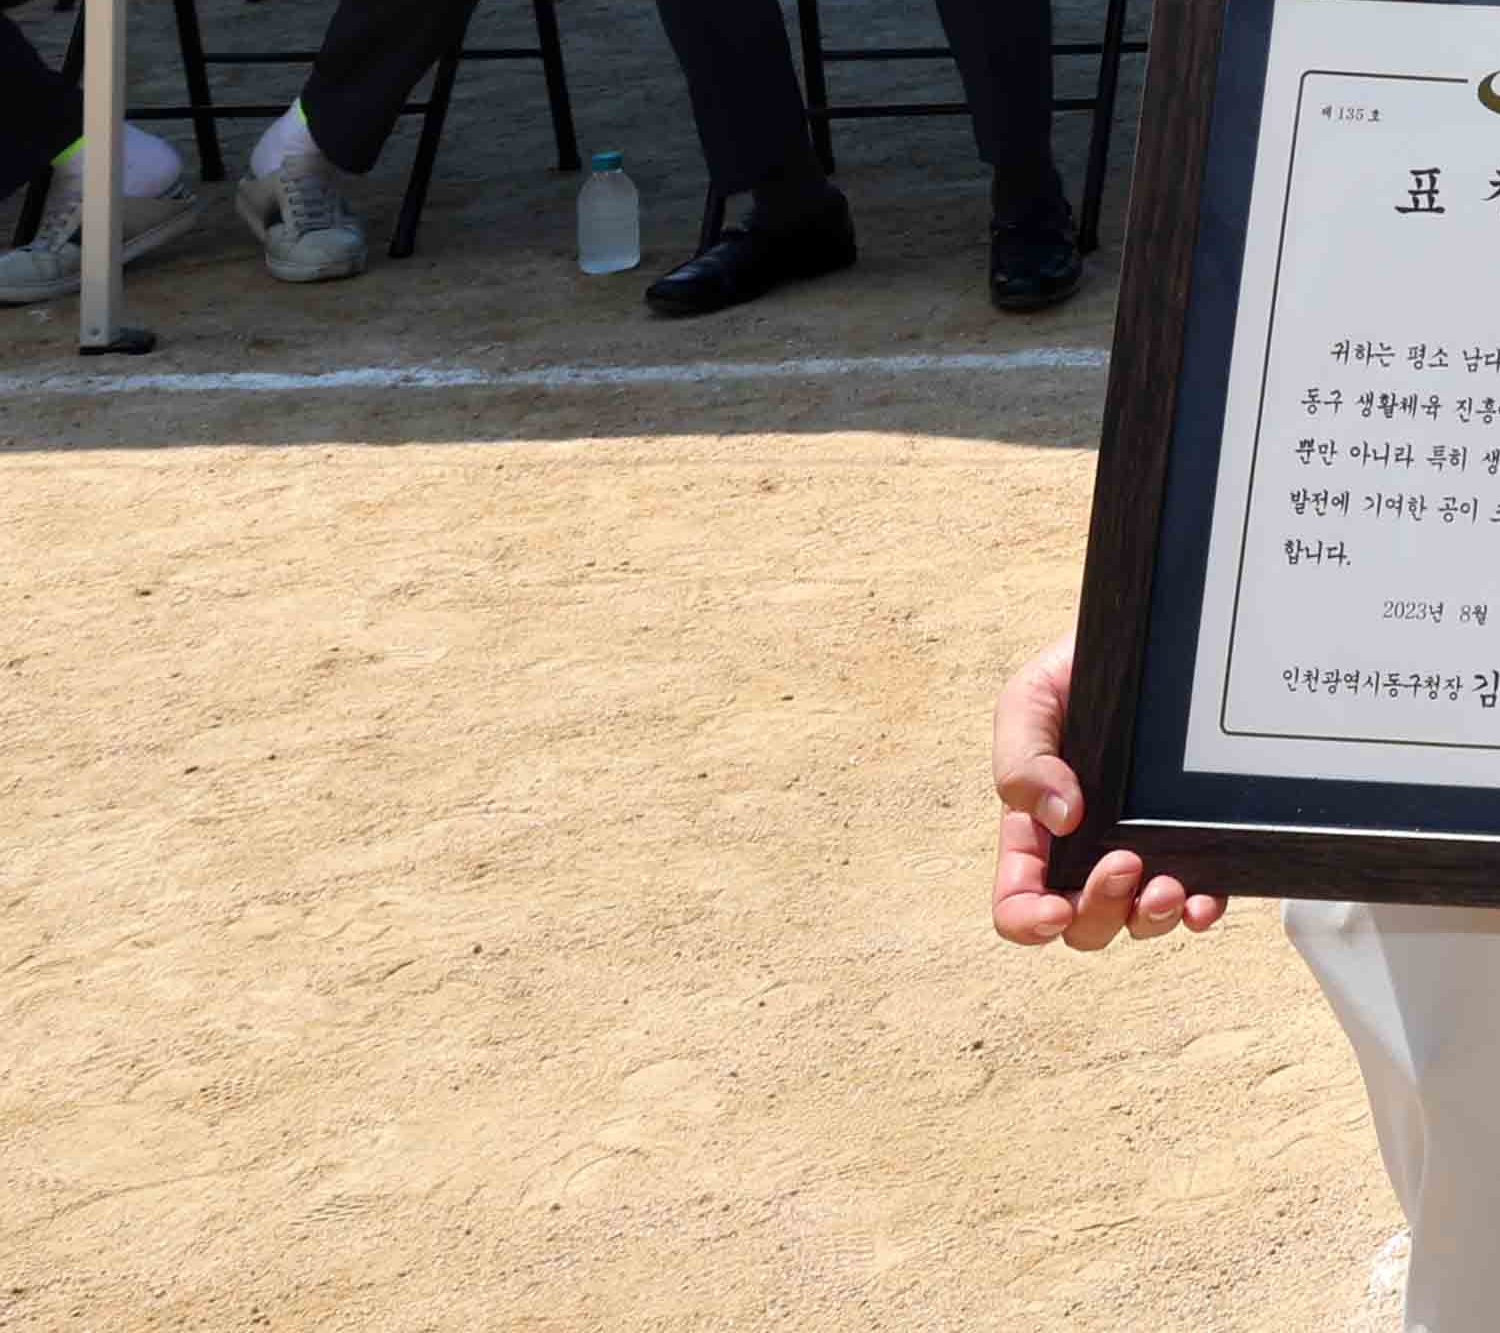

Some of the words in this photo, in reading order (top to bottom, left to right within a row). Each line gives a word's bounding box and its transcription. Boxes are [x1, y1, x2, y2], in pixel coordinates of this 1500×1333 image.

[1330, 338, 1396, 368] 귀하는
[1407, 343, 1449, 371] 평소
[1300, 387, 1344, 416] 동구
[1356, 390, 1443, 422] 생활체육
[1295, 437, 1339, 467] 뿐만
[1349, 440, 1415, 470] 아니라
[1425, 444, 1468, 472] 특히
[1289, 487, 1350, 517] 발전에
[1363, 492, 1428, 522] 기여한
[1437, 496, 1479, 524] 공이
[1283, 538, 1351, 566] 합니다.
[1383, 600, 1445, 624] 2023년
[1459, 604, 1488, 627] 8월
[1282, 666, 1464, 702] 인천광역시동구청장
